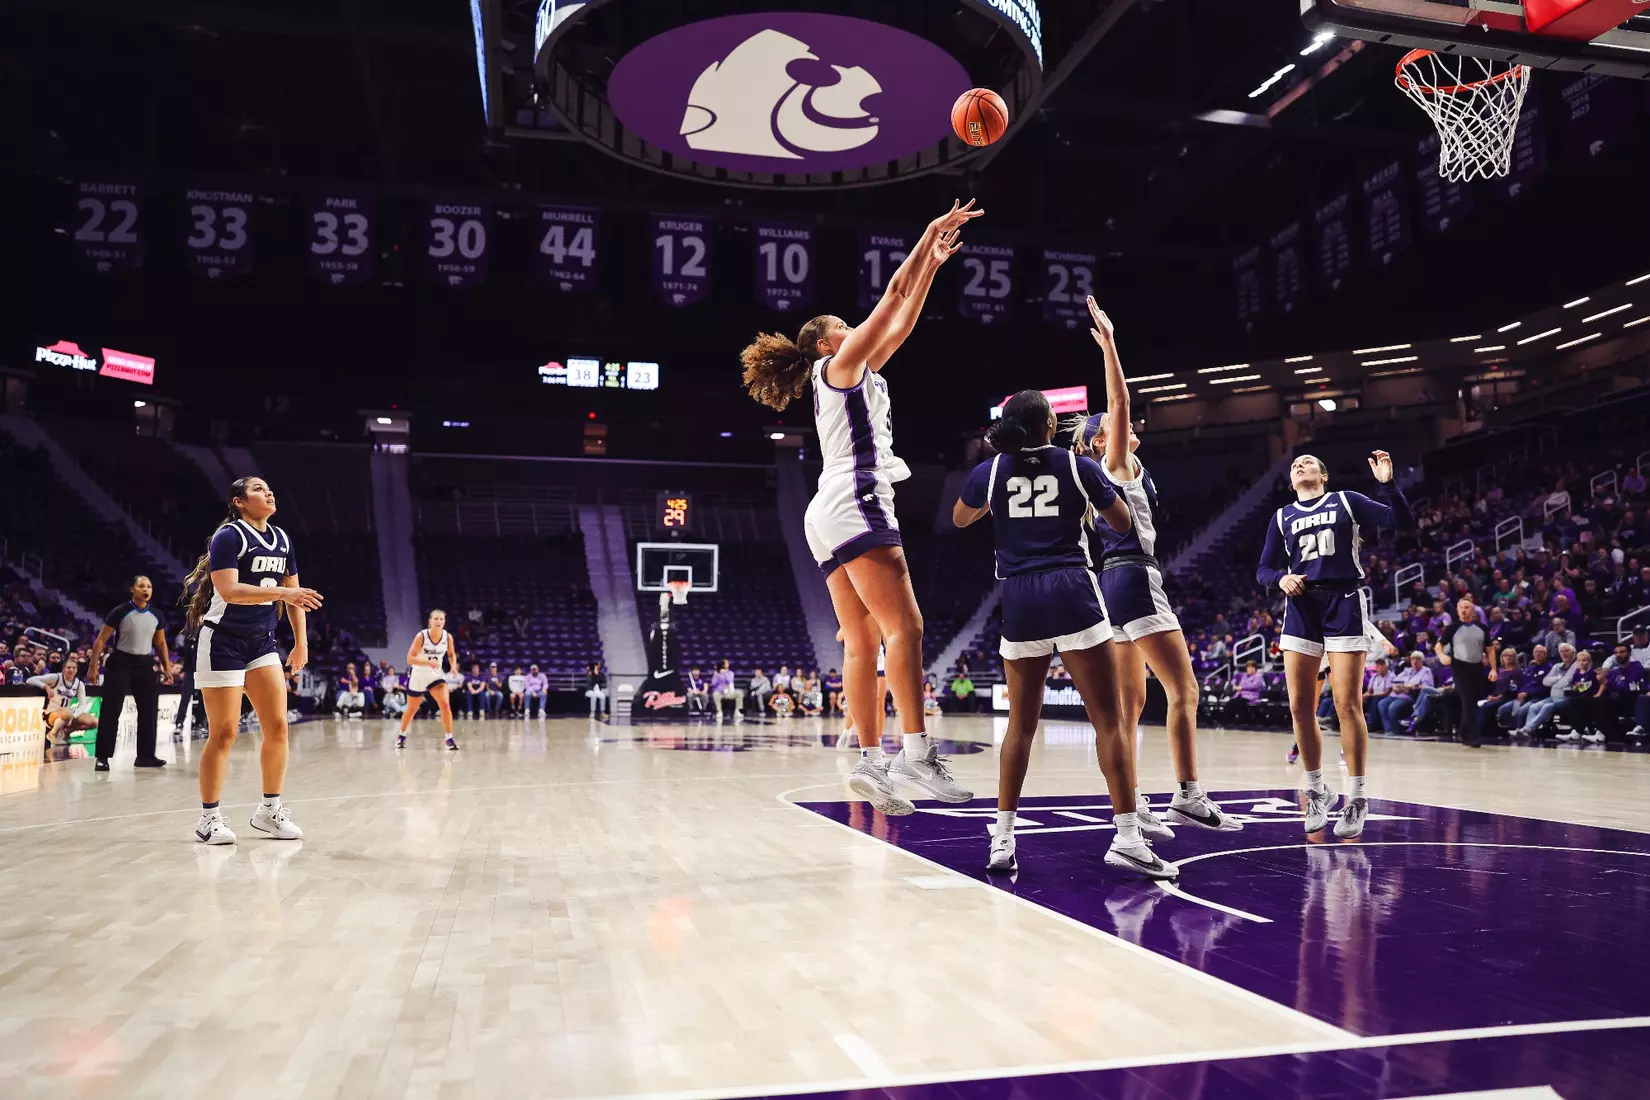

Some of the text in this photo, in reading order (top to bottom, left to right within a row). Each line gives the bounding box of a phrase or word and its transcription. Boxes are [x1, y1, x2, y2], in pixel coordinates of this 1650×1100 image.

[80, 182, 138, 196] BARRETT
[325, 198, 357, 209] PARR
[434, 204, 481, 216] BOOZER
[75, 197, 139, 243] 22
[187, 205, 247, 250] 33
[542, 211, 594, 224] MURRELL
[659, 220, 703, 232] KRUGER
[310, 212, 369, 256] 33
[428, 218, 487, 259] 30
[539, 224, 596, 267] 44
[758, 228, 811, 240] WILLIAMS
[870, 235, 905, 248] EVANS
[655, 234, 707, 277] 12
[759, 242, 809, 284] 10
[963, 258, 1012, 299] 25
[1048, 264, 1094, 304] 23
[574, 368, 592, 381] 38
[634, 371, 651, 384] 23
[1006, 474, 1060, 519] 22
[663, 508, 685, 526] 29
[1291, 510, 1337, 535] ORU
[1298, 528, 1336, 562] 20
[250, 555, 287, 574] ORU
